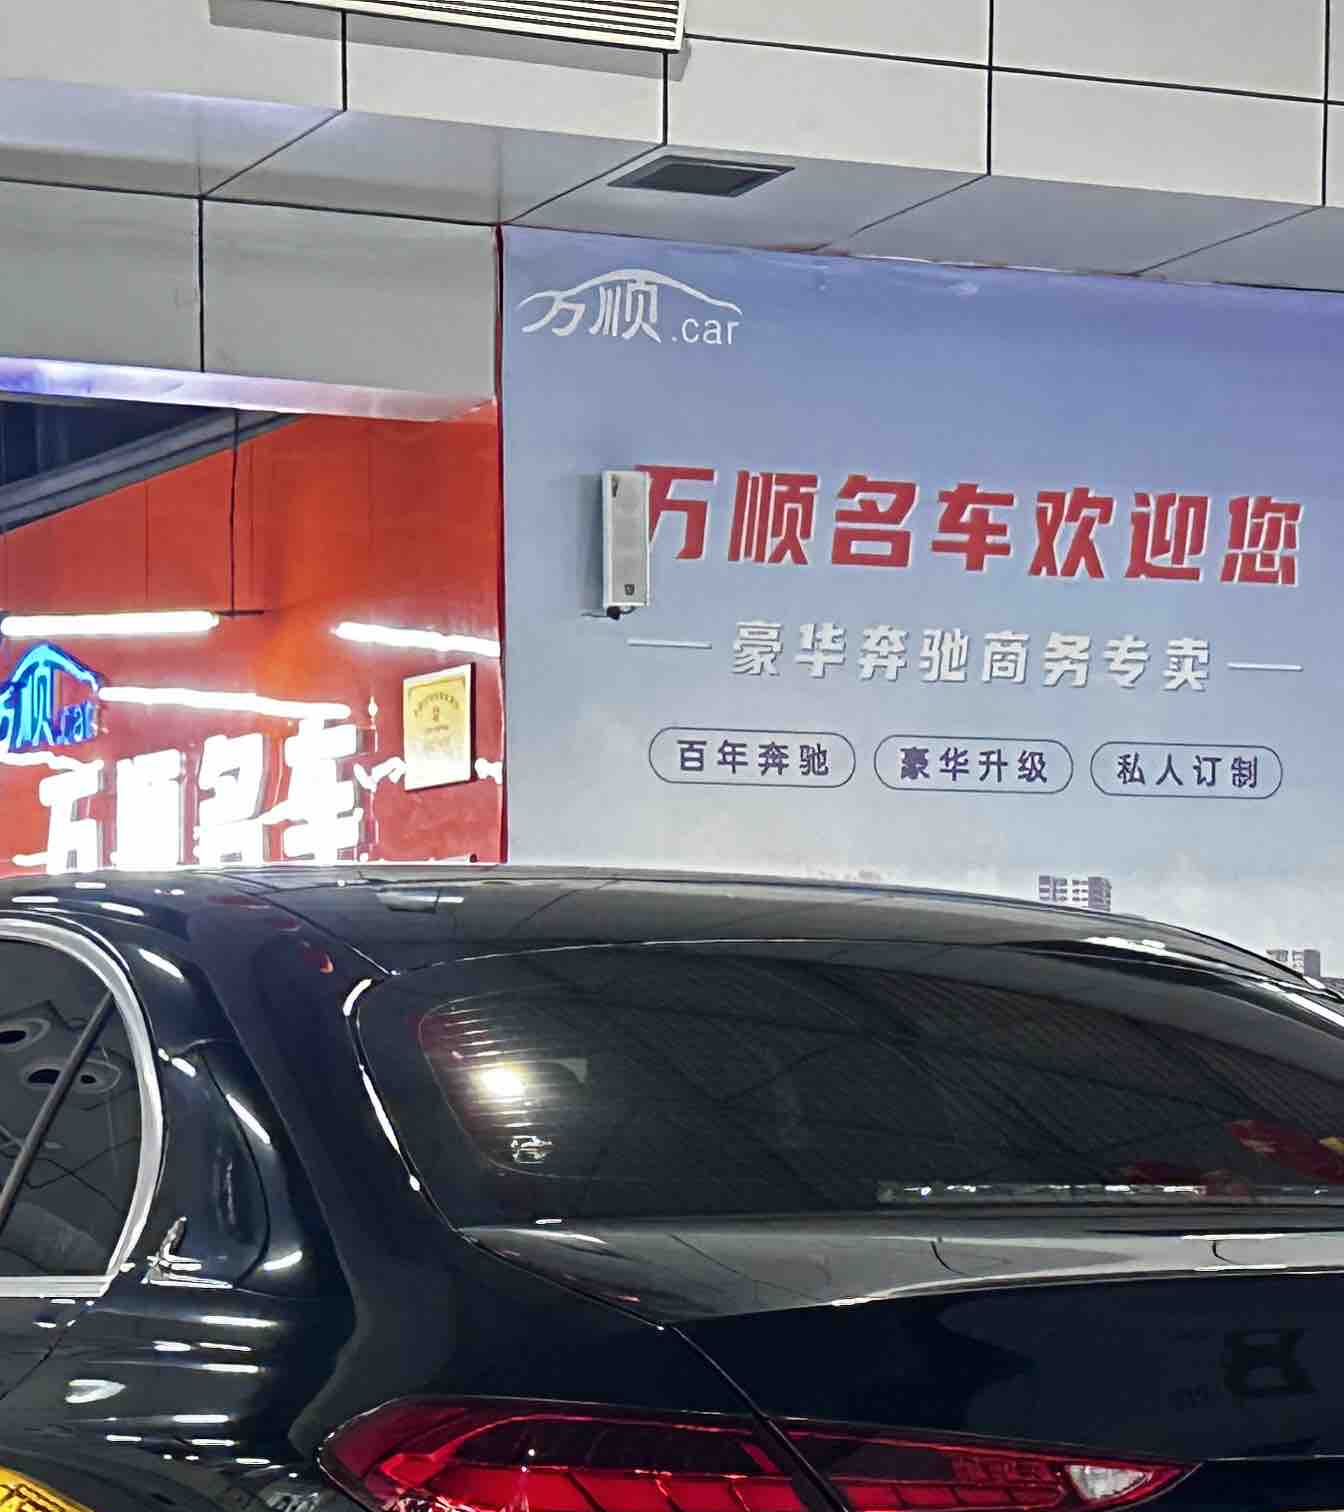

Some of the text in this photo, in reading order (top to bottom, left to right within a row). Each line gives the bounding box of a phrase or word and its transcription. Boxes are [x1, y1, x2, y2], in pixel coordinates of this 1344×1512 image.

[635, 464, 1305, 588] 万顺名车欢迎您
[730, 619, 1213, 692] 豪华奔驰商务专卖
[676, 739, 831, 777] 百年奔驰
[899, 746, 1049, 785] 豪华升级
[1116, 755, 1259, 790] 私人订制
